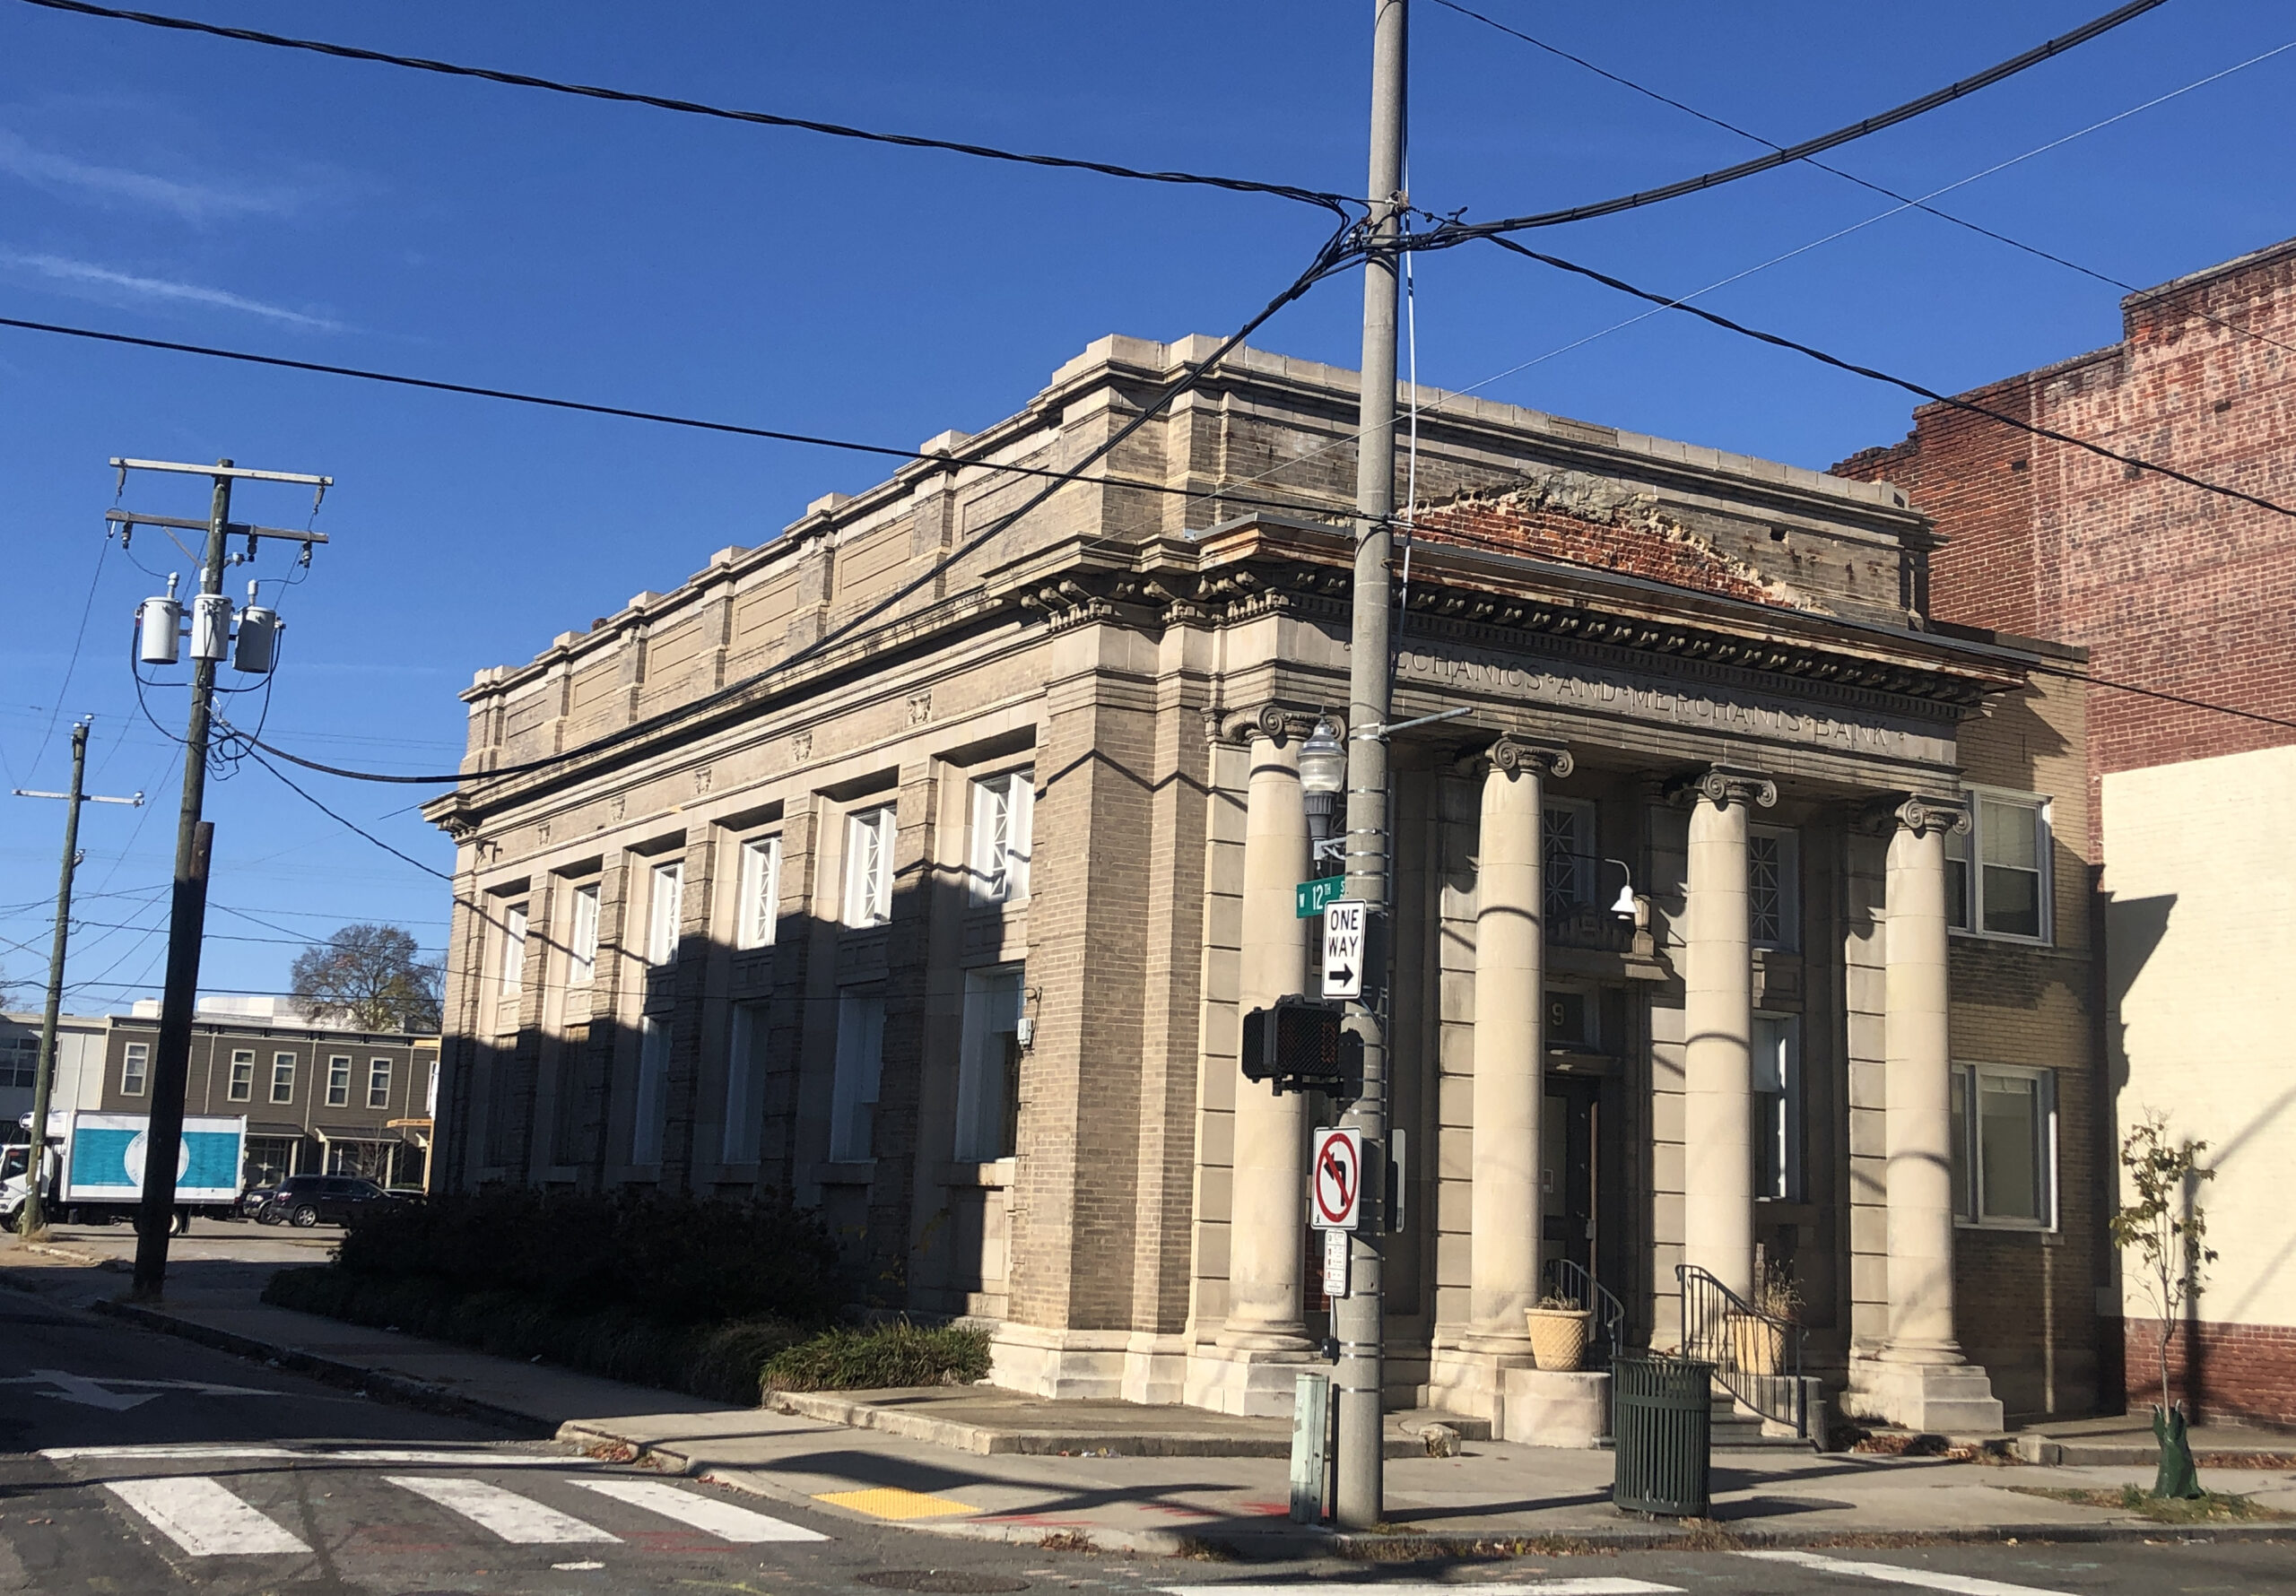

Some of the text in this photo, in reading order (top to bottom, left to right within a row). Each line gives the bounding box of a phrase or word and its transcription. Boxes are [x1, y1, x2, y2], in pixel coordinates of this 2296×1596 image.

[1557, 671, 1617, 702] AND
[1631, 681, 1802, 732] MERCHANTS
[1815, 711, 1888, 746] BANK
[1299, 893, 1305, 908] W
[1312, 883, 1331, 910] 12TH
[1330, 909, 1359, 931] ONE
[1328, 936, 1359, 958] WAY
